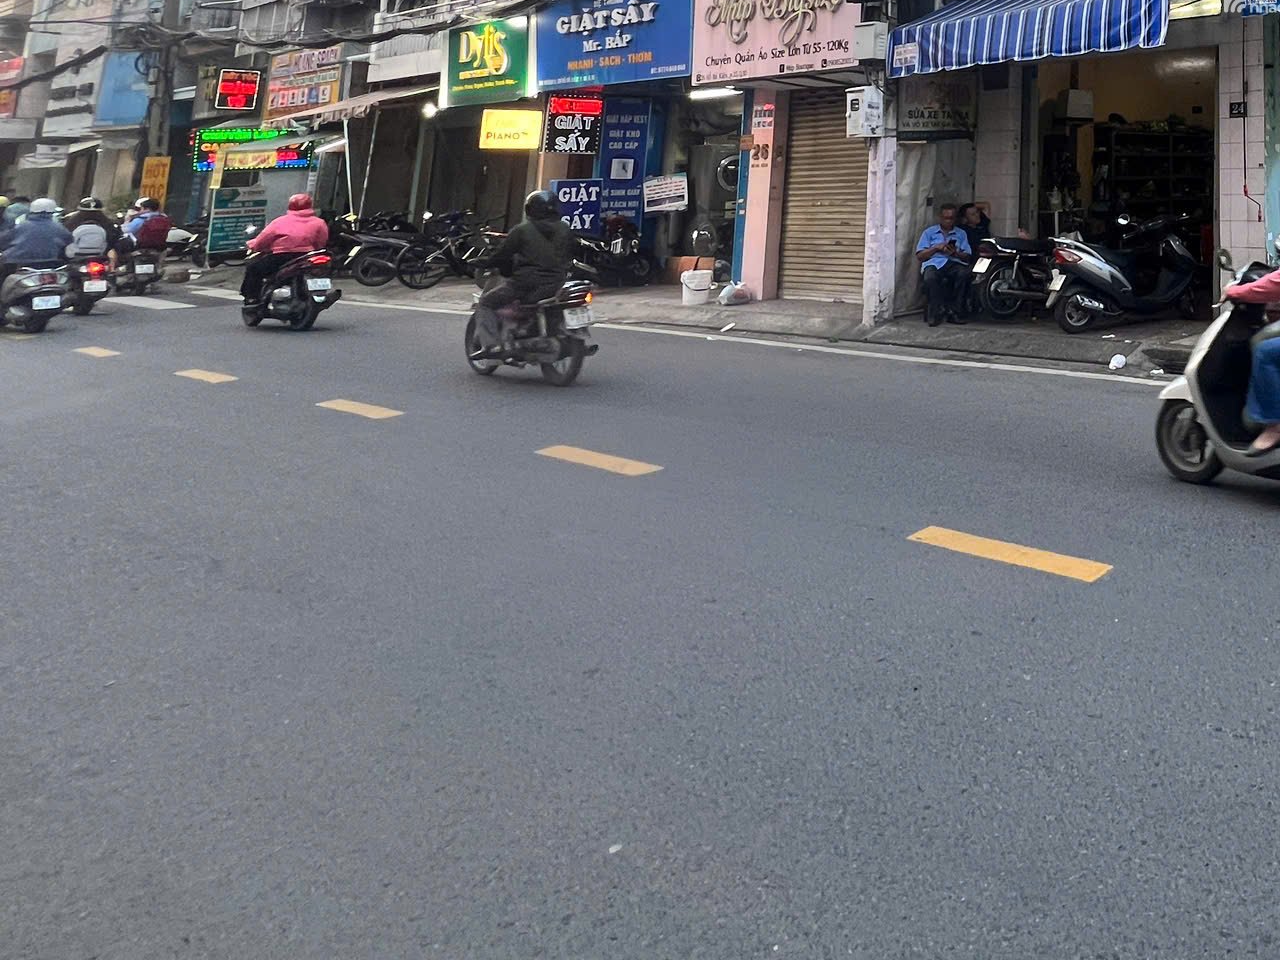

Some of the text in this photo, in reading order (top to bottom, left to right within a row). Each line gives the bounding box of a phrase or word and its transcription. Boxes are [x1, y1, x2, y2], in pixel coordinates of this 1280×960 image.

[556, 8, 610, 36] GIẶT
[582, 39, 603, 52] Mr.
[771, 46, 785, 59] Size
[1231, 103, 1245, 114] 24
[554, 114, 594, 132] GIẶT
[486, 131, 520, 140] PIANO
[554, 131, 590, 151] SẤY
[558, 183, 600, 206] GIẶT
